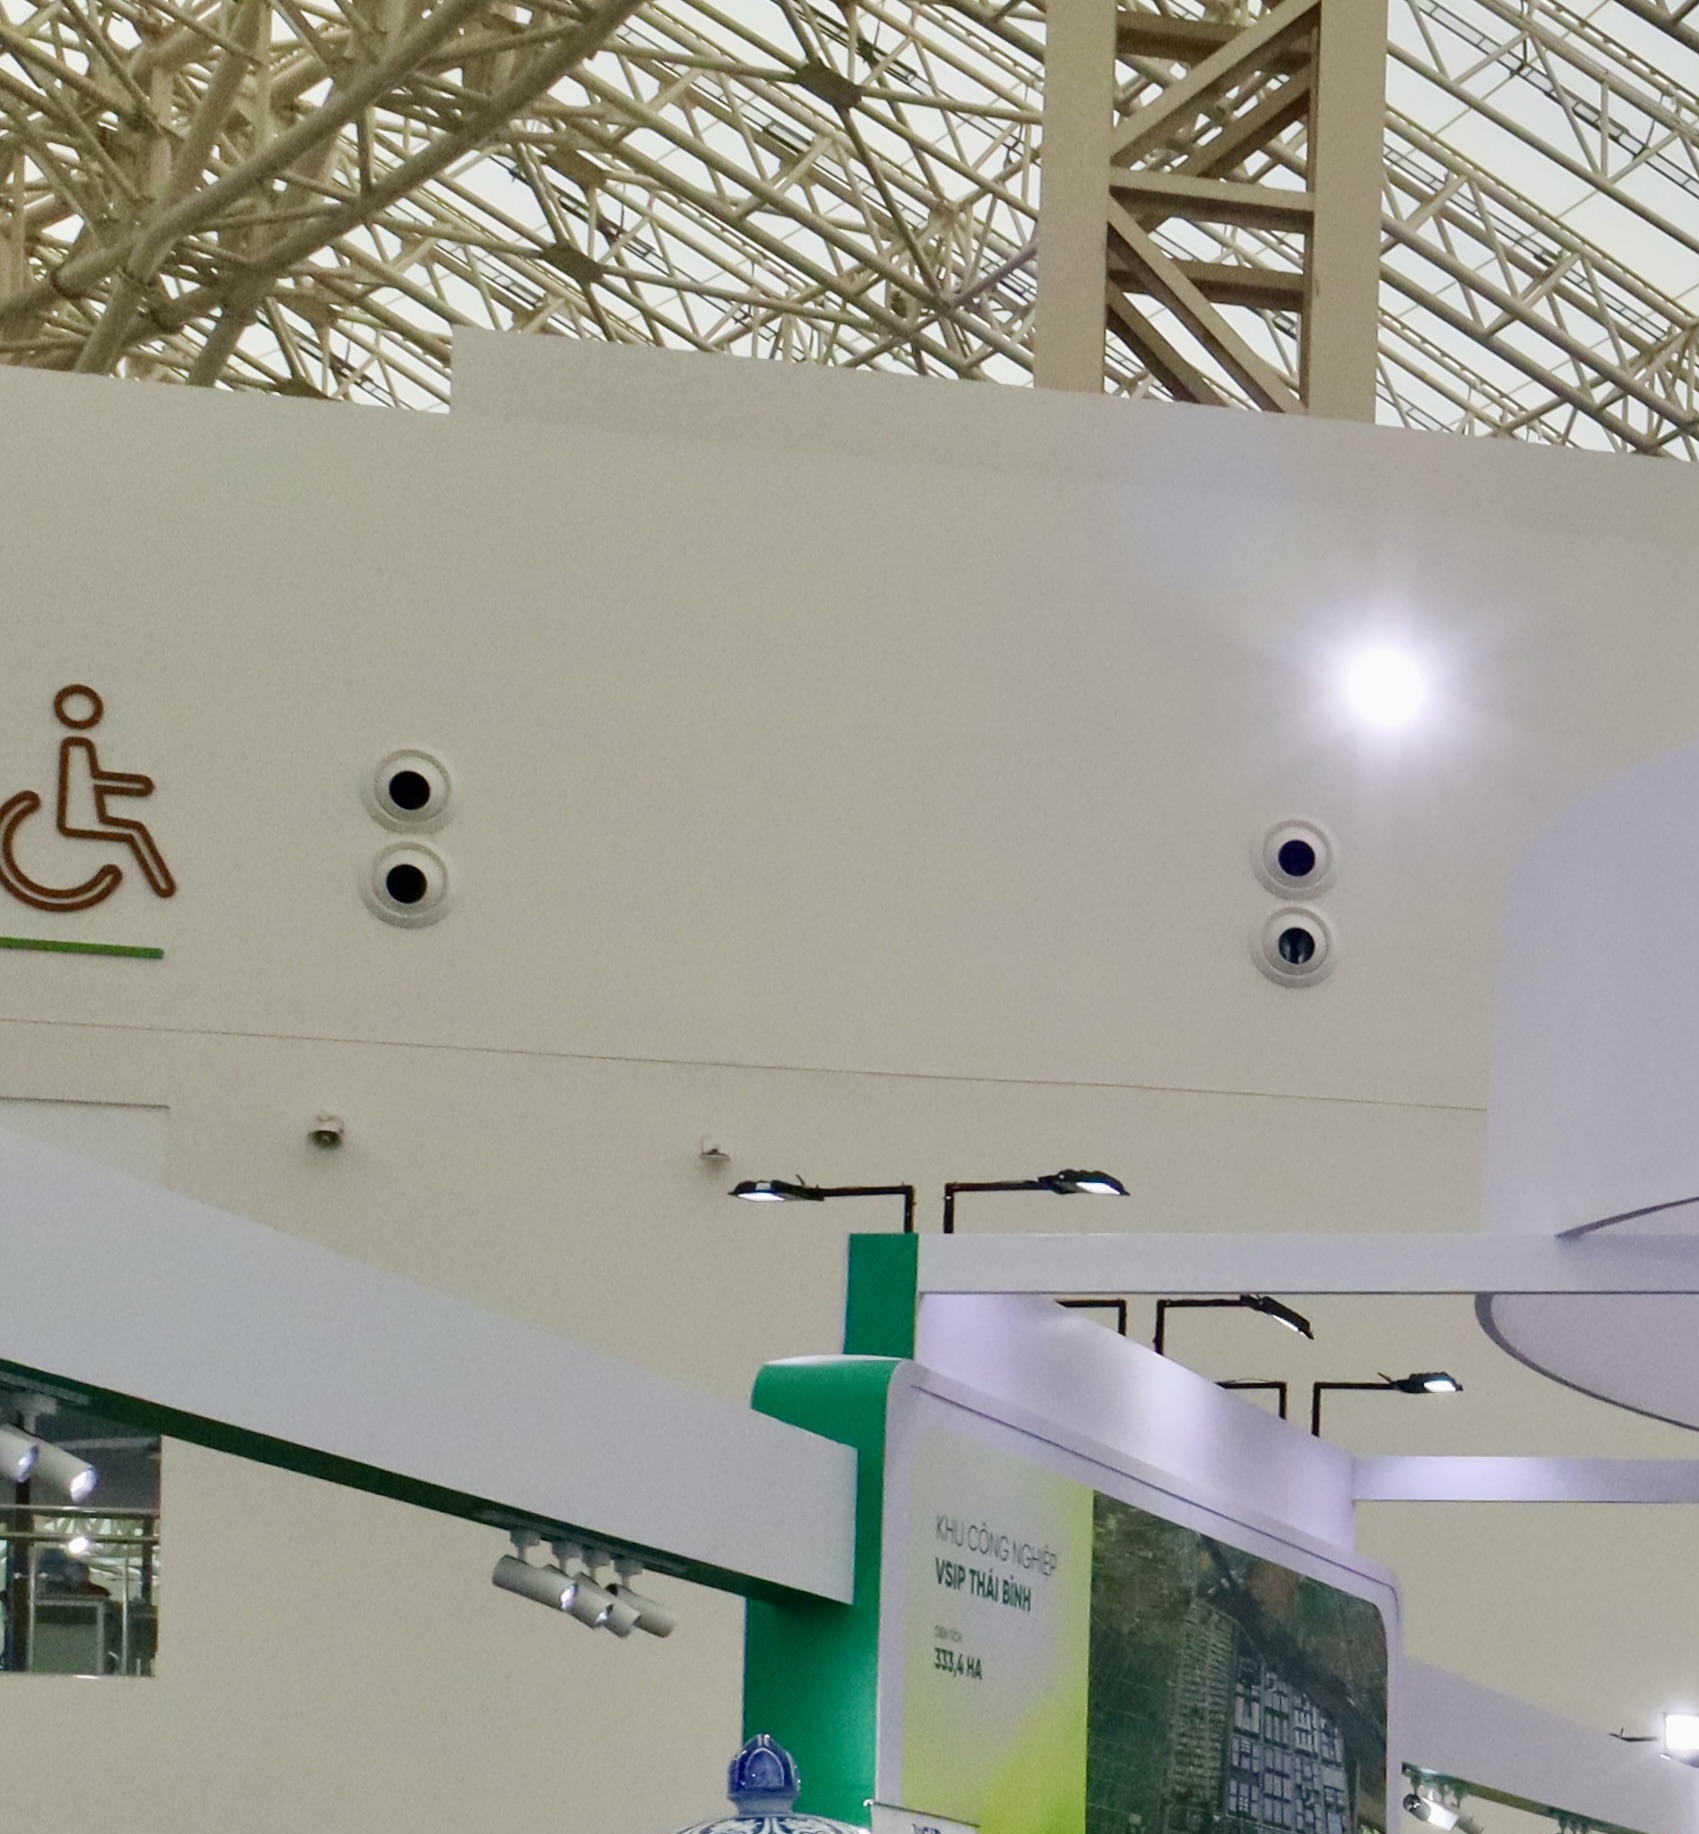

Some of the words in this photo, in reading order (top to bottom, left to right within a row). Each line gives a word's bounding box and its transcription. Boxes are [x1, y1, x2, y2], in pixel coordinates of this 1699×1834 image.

[936, 1515, 964, 1548] KHU
[968, 1522, 1009, 1563] CÔNG
[1014, 1540, 1057, 1581] NGHIỆP
[935, 1557, 966, 1591] VSIP
[969, 1565, 998, 1602] THÁI
[1002, 1574, 1031, 1613] BÌNH
[934, 1647, 964, 1678] 333,4
[966, 1654, 983, 1680] HA
